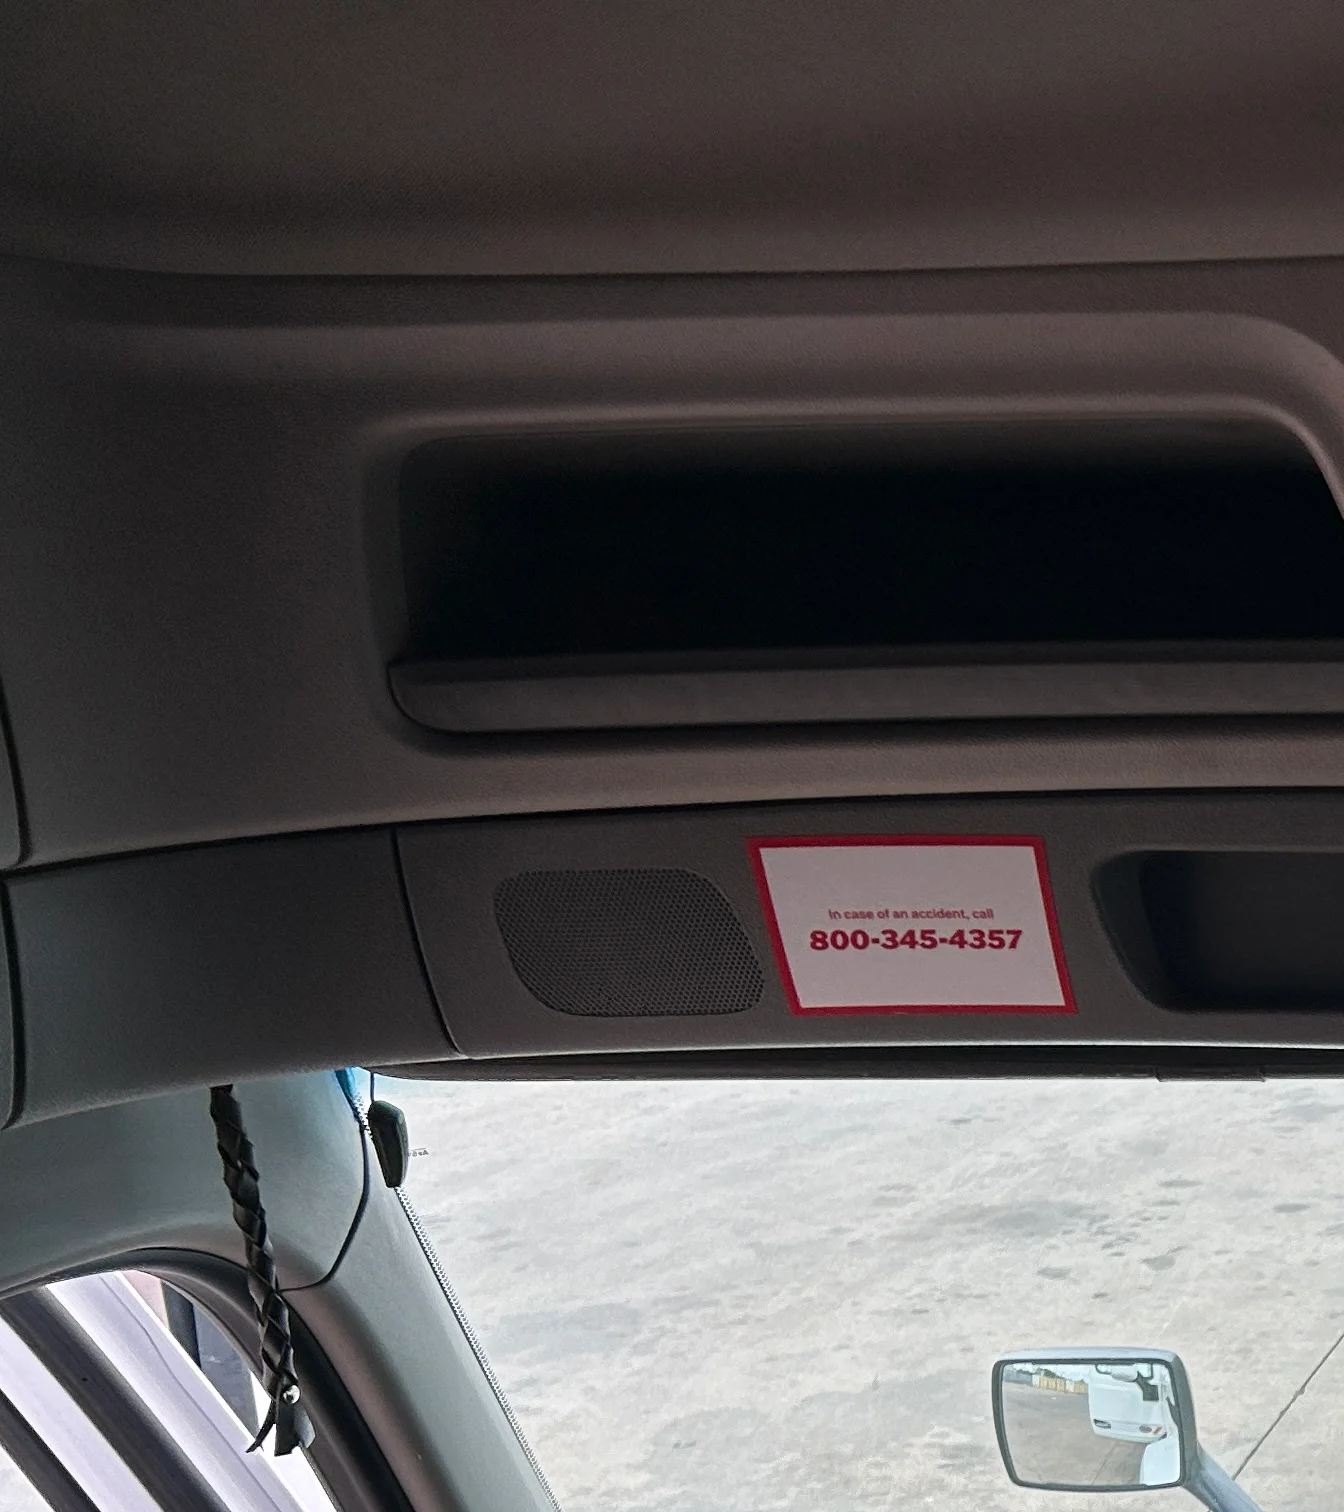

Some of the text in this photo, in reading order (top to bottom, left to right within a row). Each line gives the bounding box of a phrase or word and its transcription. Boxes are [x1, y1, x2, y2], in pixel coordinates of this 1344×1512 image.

[828, 908, 994, 921] In case of an accident, call
[809, 928, 1023, 951] 800-345-4357
